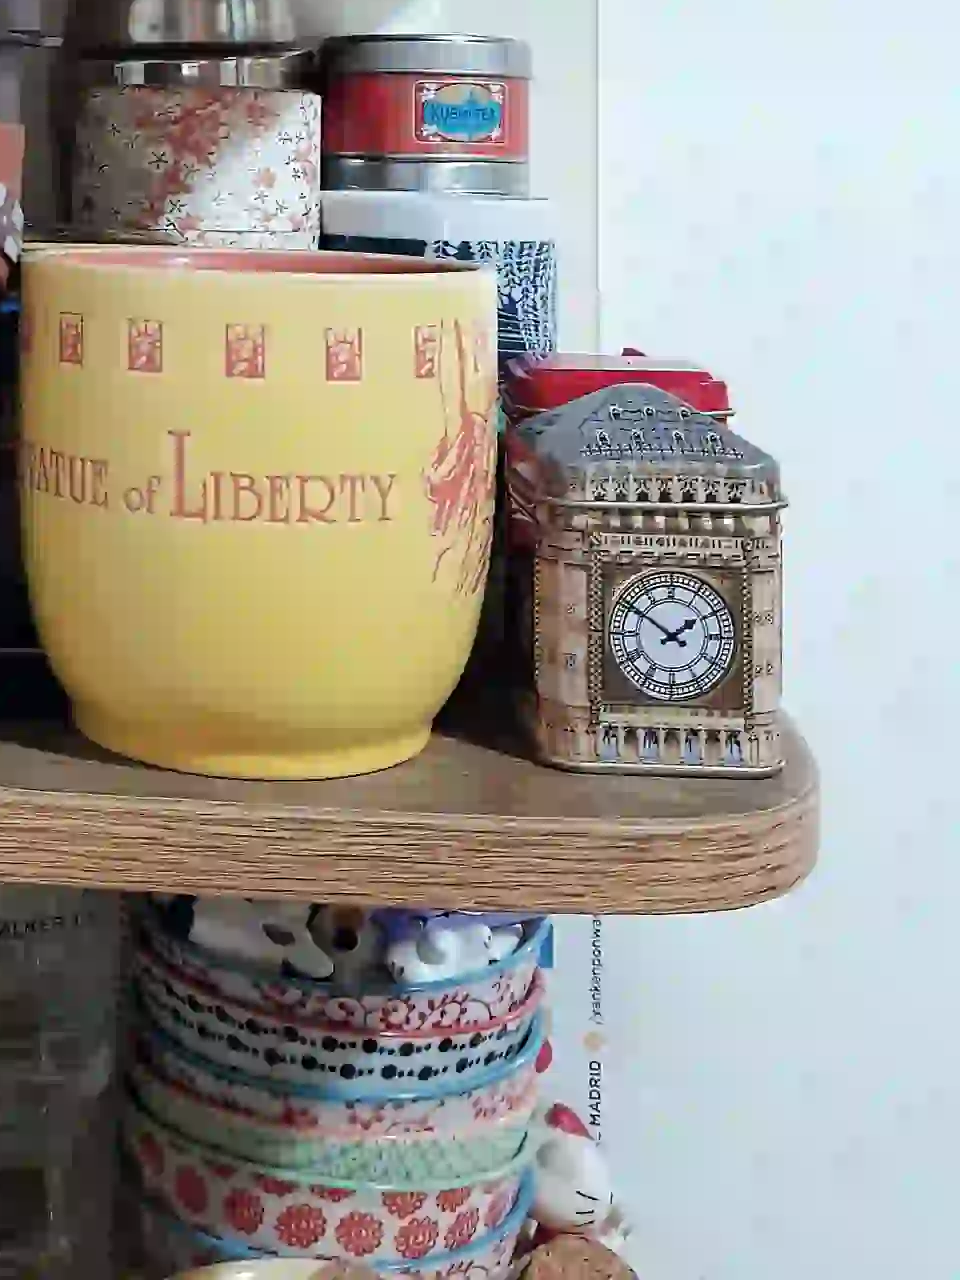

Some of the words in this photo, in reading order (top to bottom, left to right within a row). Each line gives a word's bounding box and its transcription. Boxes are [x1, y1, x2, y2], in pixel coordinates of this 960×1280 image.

[122, 475, 161, 514] of
[167, 429, 397, 523] LIBERTY
[589, 1060, 602, 1126] MADRID
